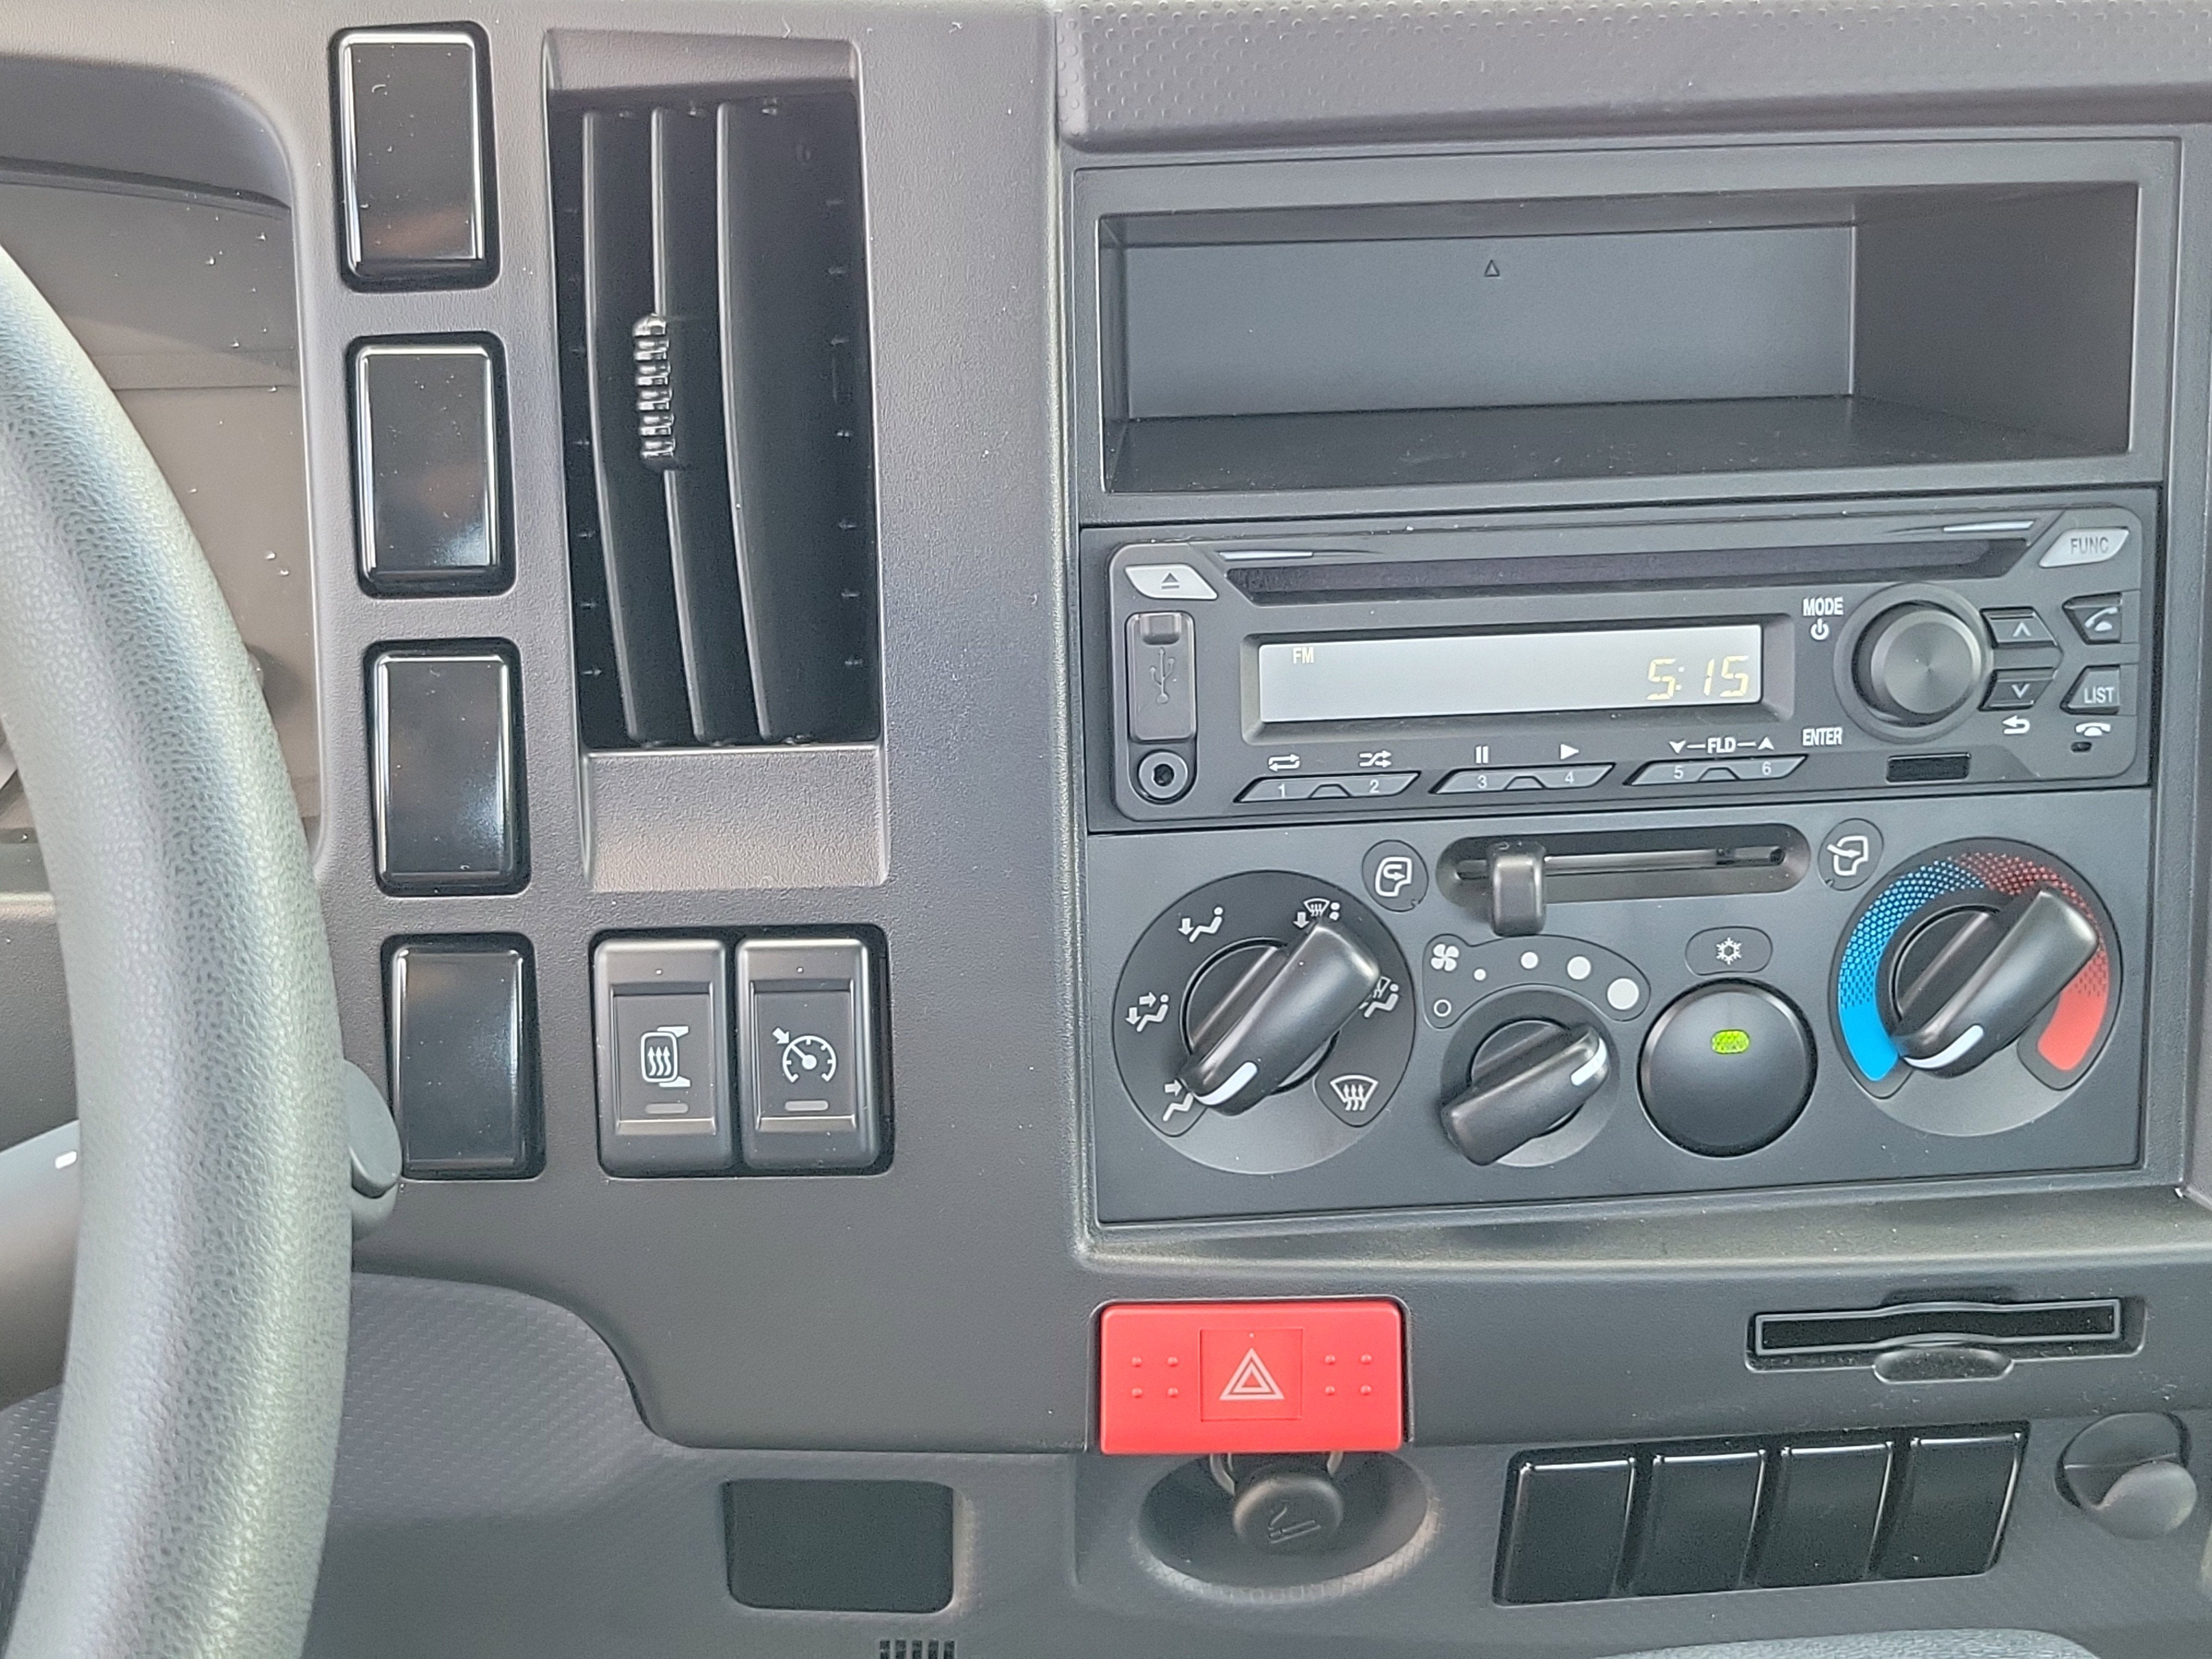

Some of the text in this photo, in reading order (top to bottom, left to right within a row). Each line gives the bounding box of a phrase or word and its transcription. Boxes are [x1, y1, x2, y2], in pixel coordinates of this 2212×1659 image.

[2070, 537, 2109, 555] FUNC
[1803, 597, 1844, 616] MODE
[1293, 646, 1314, 664] FM
[1647, 655, 1749, 700] 5:15
[2084, 687, 2114, 704] LIST
[1803, 726, 1843, 746] ENTER
[1707, 737, 1736, 754] FLD
[1565, 769, 1575, 785] 4
[1674, 765, 1684, 780] 5
[1762, 761, 1772, 776] 6
[1369, 778, 1380, 794] 2
[1477, 774, 1488, 790] 3
[1277, 783, 1286, 799] 1
